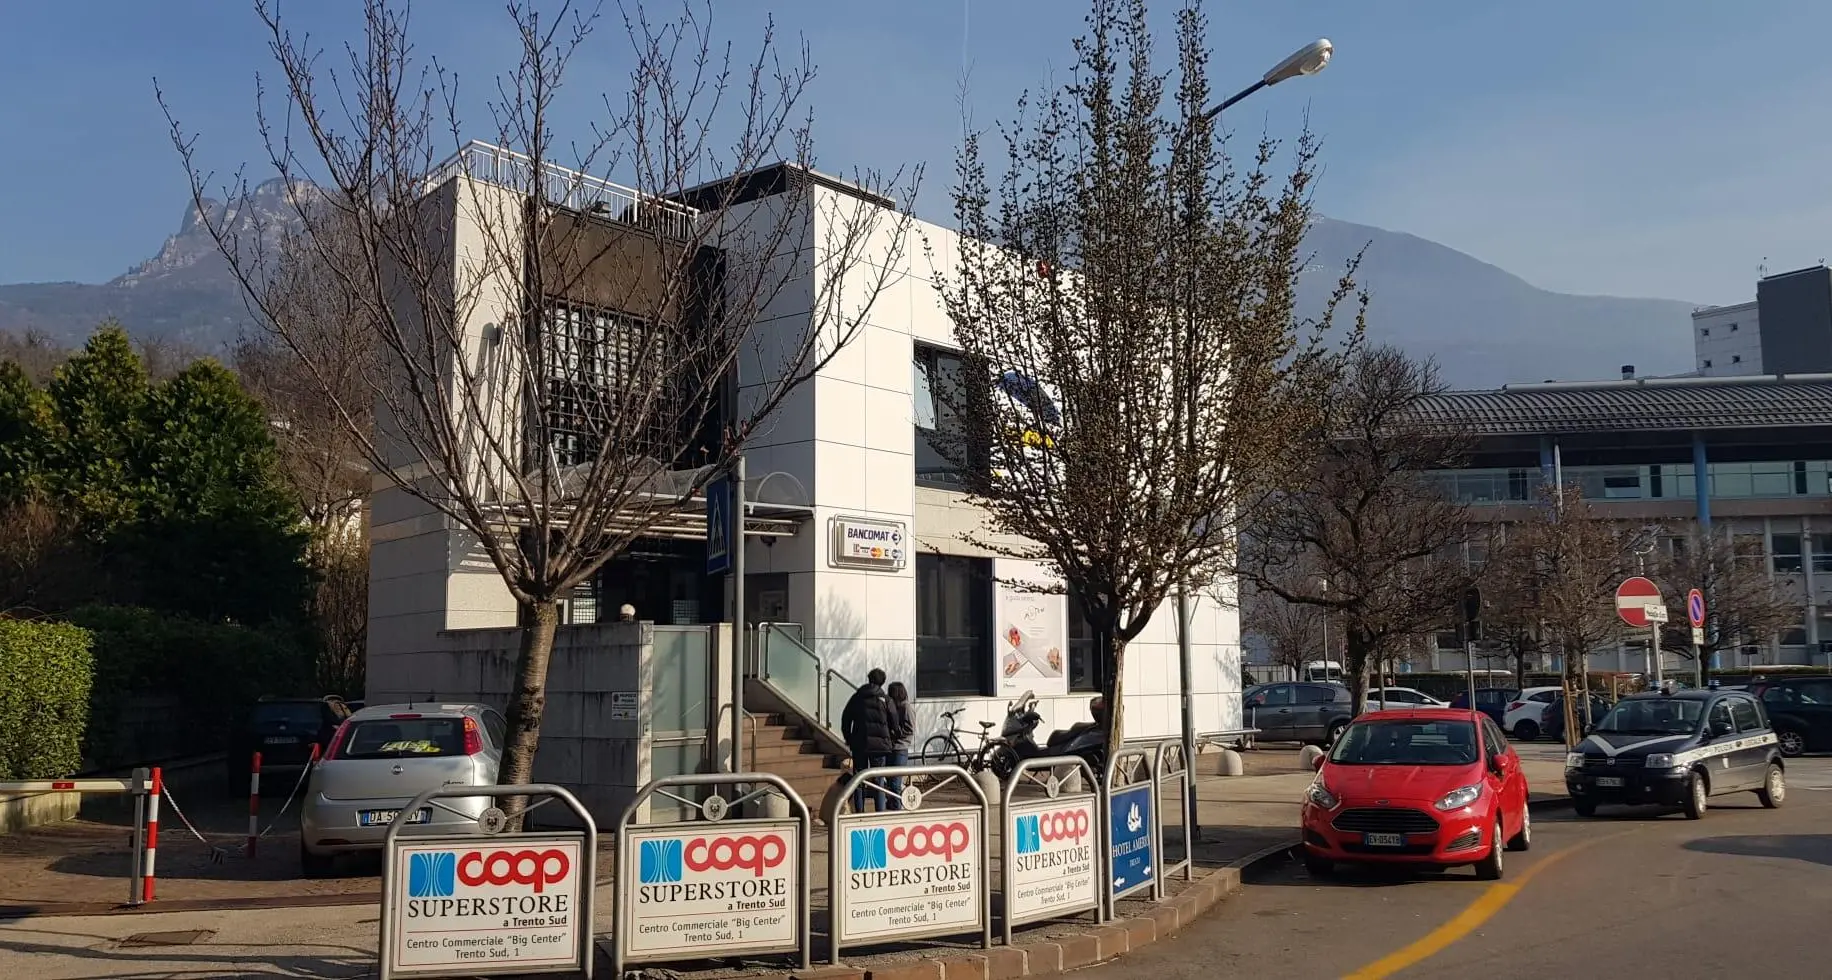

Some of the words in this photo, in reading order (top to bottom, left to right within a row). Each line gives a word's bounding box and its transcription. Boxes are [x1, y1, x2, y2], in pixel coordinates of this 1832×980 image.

[848, 528, 889, 541] BANCOMAT
[1040, 809, 1088, 845] coop
[888, 822, 969, 862] coop
[1113, 841, 1132, 857] HOTEL
[684, 835, 786, 877] coop
[1017, 846, 1089, 872] SUPERSTORE
[457, 849, 569, 893] coop
[851, 863, 970, 889] SUPERSTORE
[1067, 866, 1081, 874] Trento
[640, 878, 785, 903] SUPERSTORE
[931, 885, 955, 894] Trento
[958, 882, 970, 890] Sud
[1018, 888, 1034, 898] Centro
[1035, 882, 1063, 895] Commerciale
[408, 895, 568, 917] SUPERSTORE
[737, 900, 765, 910] Trento
[769, 898, 785, 908] Sud
[1041, 895, 1055, 904] Trento
[852, 908, 876, 918] Centro
[879, 903, 924, 915] Commerciale
[513, 916, 545, 926] Trento
[549, 915, 567, 925] Sud
[640, 924, 669, 934] Centro
[672, 921, 728, 932] Commerciale
[889, 916, 911, 926] Trento
[407, 939, 438, 949] Centro
[442, 936, 503, 948] Commerciale
[684, 933, 712, 942] Trento
[455, 949, 485, 959] Trento
[514, 948, 519, 956] 1
